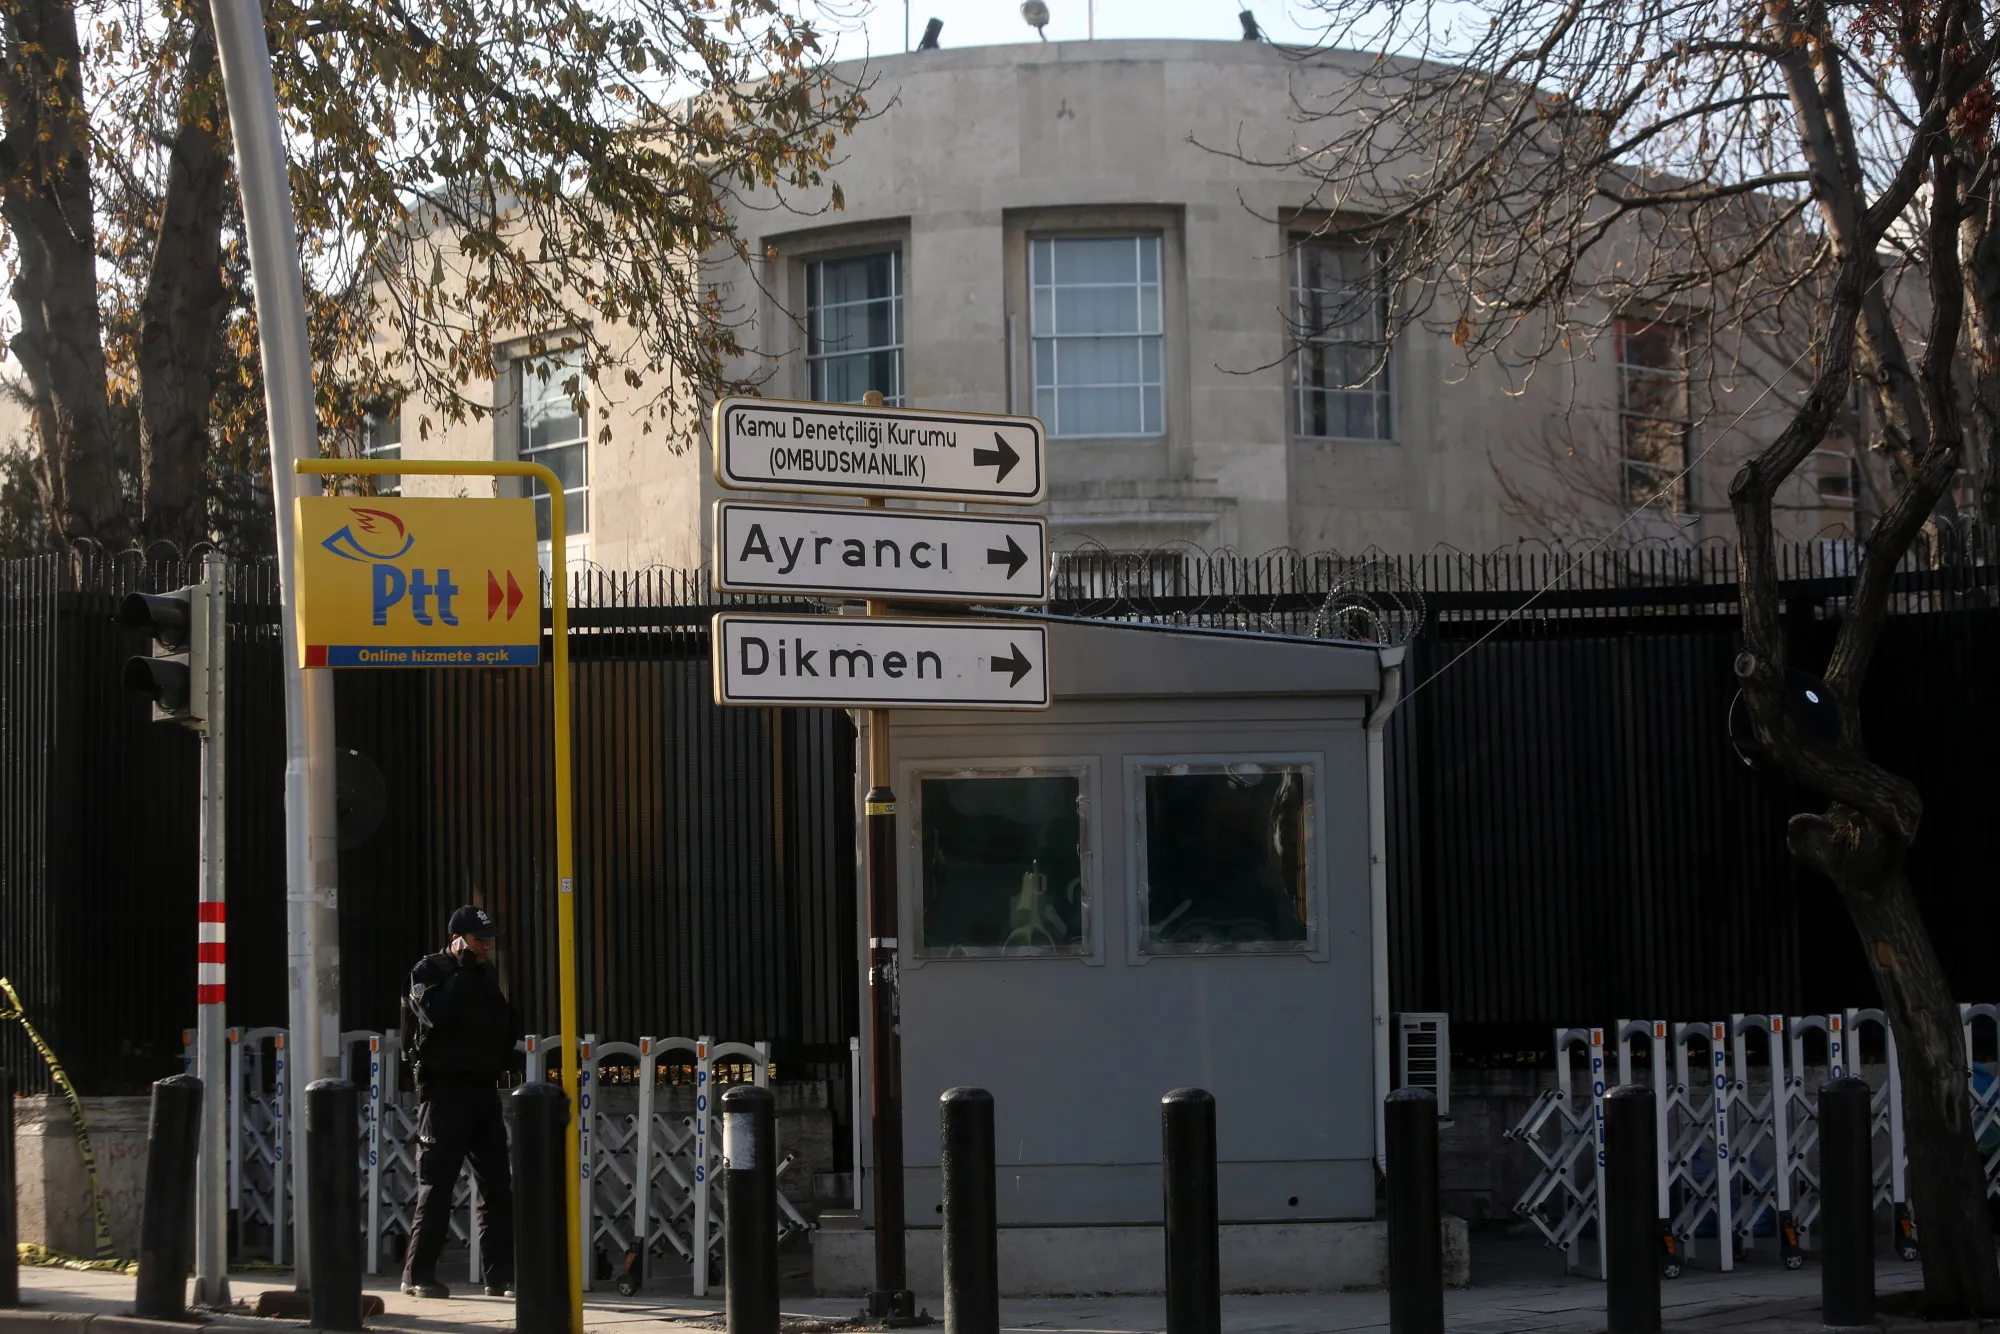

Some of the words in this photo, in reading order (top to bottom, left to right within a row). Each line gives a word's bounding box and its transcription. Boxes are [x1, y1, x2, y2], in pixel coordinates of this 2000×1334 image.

[735, 413, 786, 439] Kamu
[792, 416, 882, 449] Denetçiliği
[887, 422, 957, 448] Kurumu
[769, 447, 926, 483] (OMBUDSMANLIK)
[739, 523, 948, 575] Ayrancı
[372, 563, 459, 626] Ptt
[358, 649, 407, 662] Online
[411, 649, 472, 662] hizmete
[476, 649, 509, 664] açık
[740, 636, 942, 679] Dikmen
[275, 1060, 284, 1161] POLİS
[370, 1062, 379, 1166] POLİS
[581, 1070, 591, 1179] POLİS
[696, 1071, 707, 1182] POLİS
[1714, 1051, 1728, 1160] POLİS
